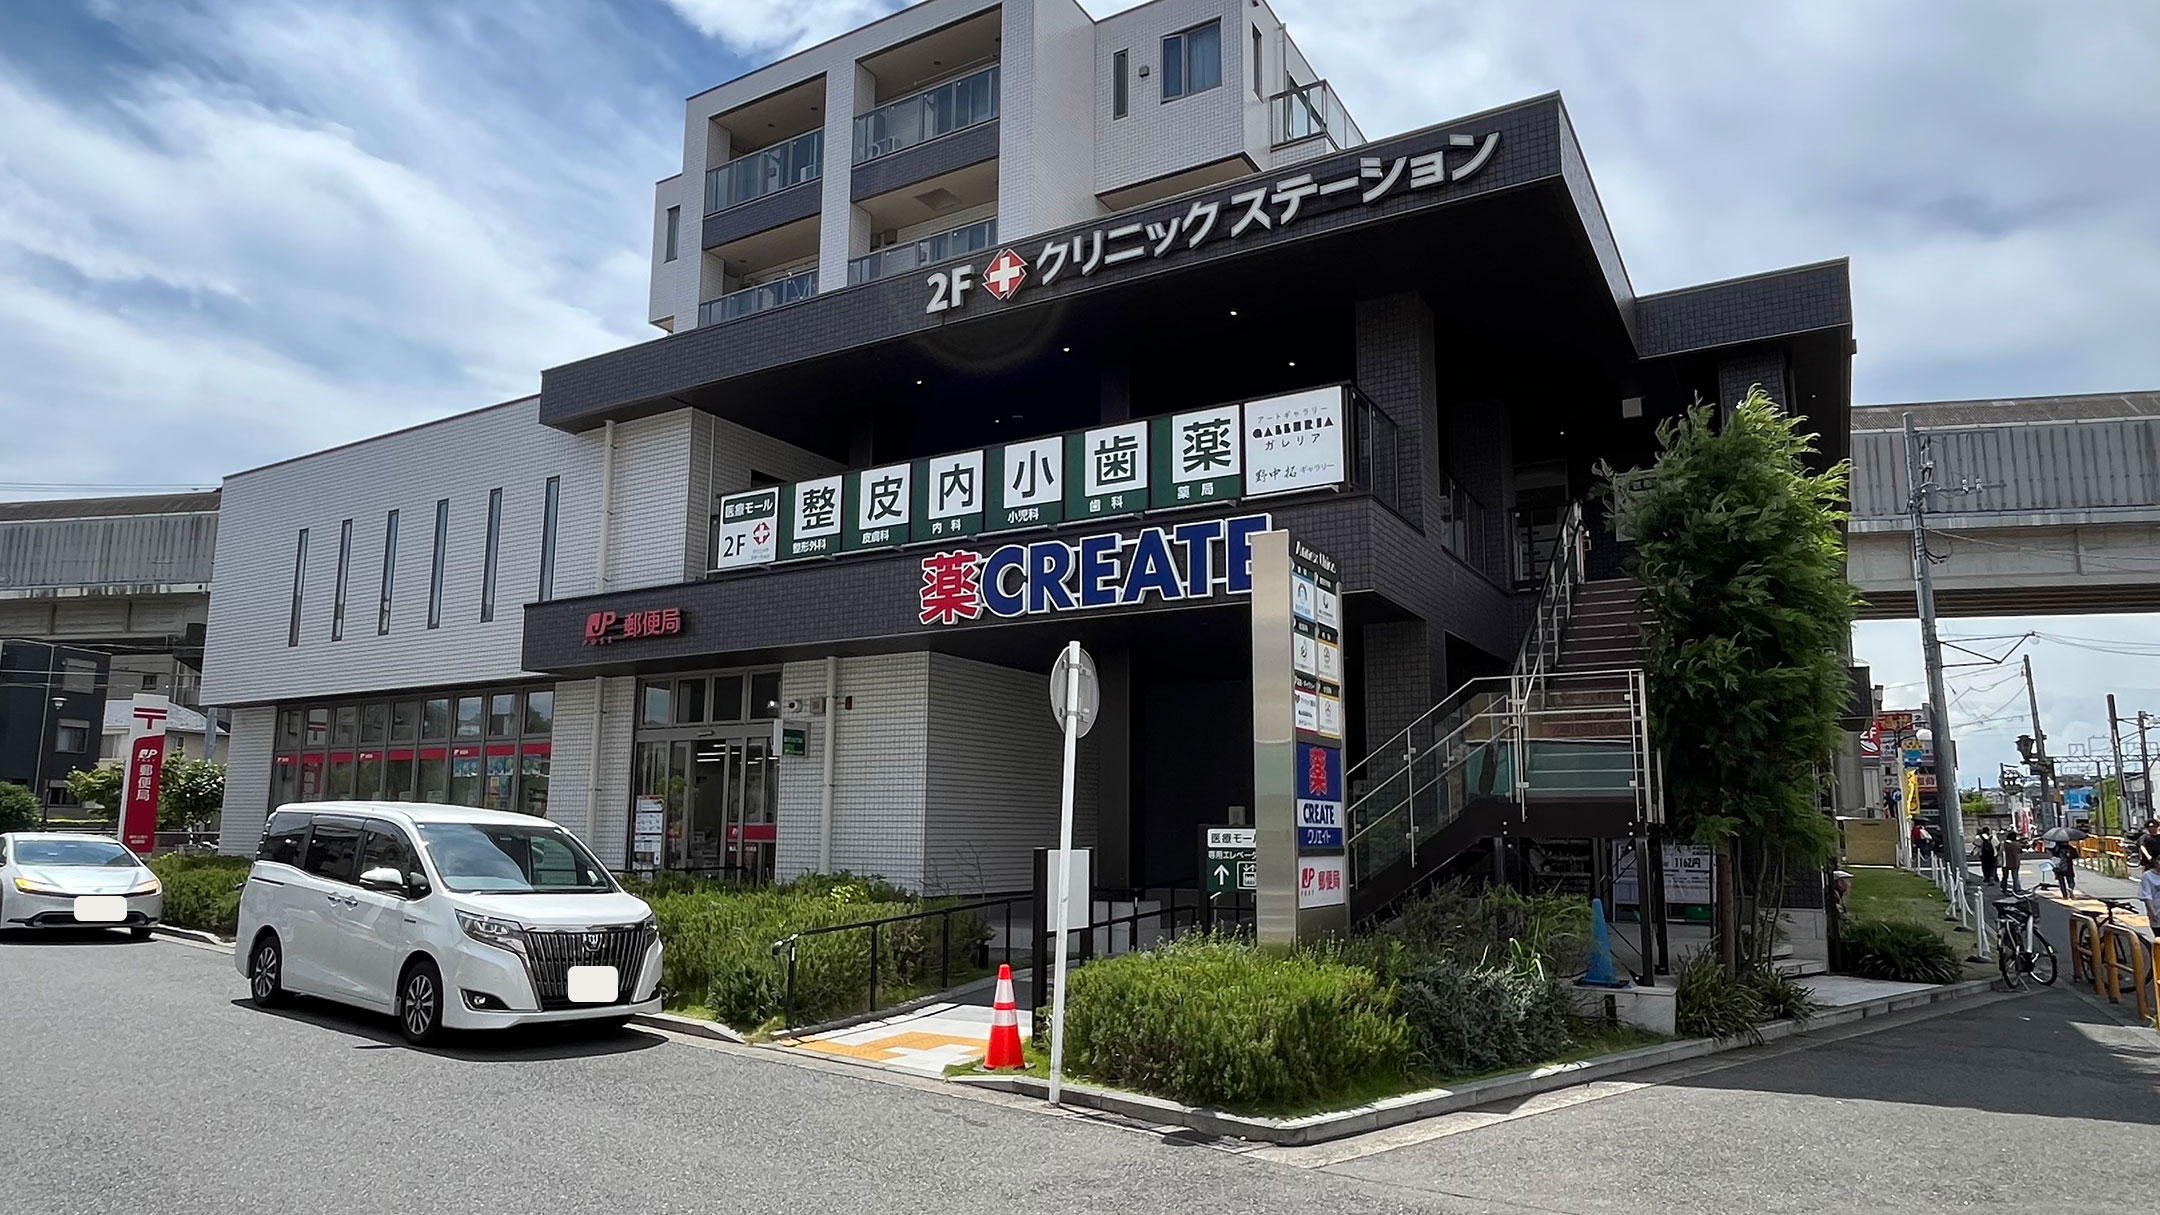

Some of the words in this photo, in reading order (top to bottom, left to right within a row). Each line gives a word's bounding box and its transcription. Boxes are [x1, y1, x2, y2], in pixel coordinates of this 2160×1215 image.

[926, 263, 972, 315] 2F
[1036, 131, 1500, 287] クリニックステーション
[1182, 417, 1232, 474] 薬
[1252, 416, 1334, 439] GALLERIA
[1264, 433, 1321, 451] ガレリア
[1012, 449, 1055, 499] 小
[1093, 434, 1139, 487] 歯
[867, 475, 904, 522] 皮
[938, 462, 975, 512] 内
[724, 498, 774, 519] 医療モール
[801, 485, 836, 532] 整
[723, 533, 747, 558] 2F
[919, 550, 983, 625] 薬
[623, 607, 681, 638] 郵便局
[136, 764, 154, 801] 郵便局
[1308, 747, 1328, 796] 薬
[1303, 803, 1335, 825] CREATE
[1307, 829, 1332, 844] クリエイト
[1318, 870, 1341, 892] 郵便局
